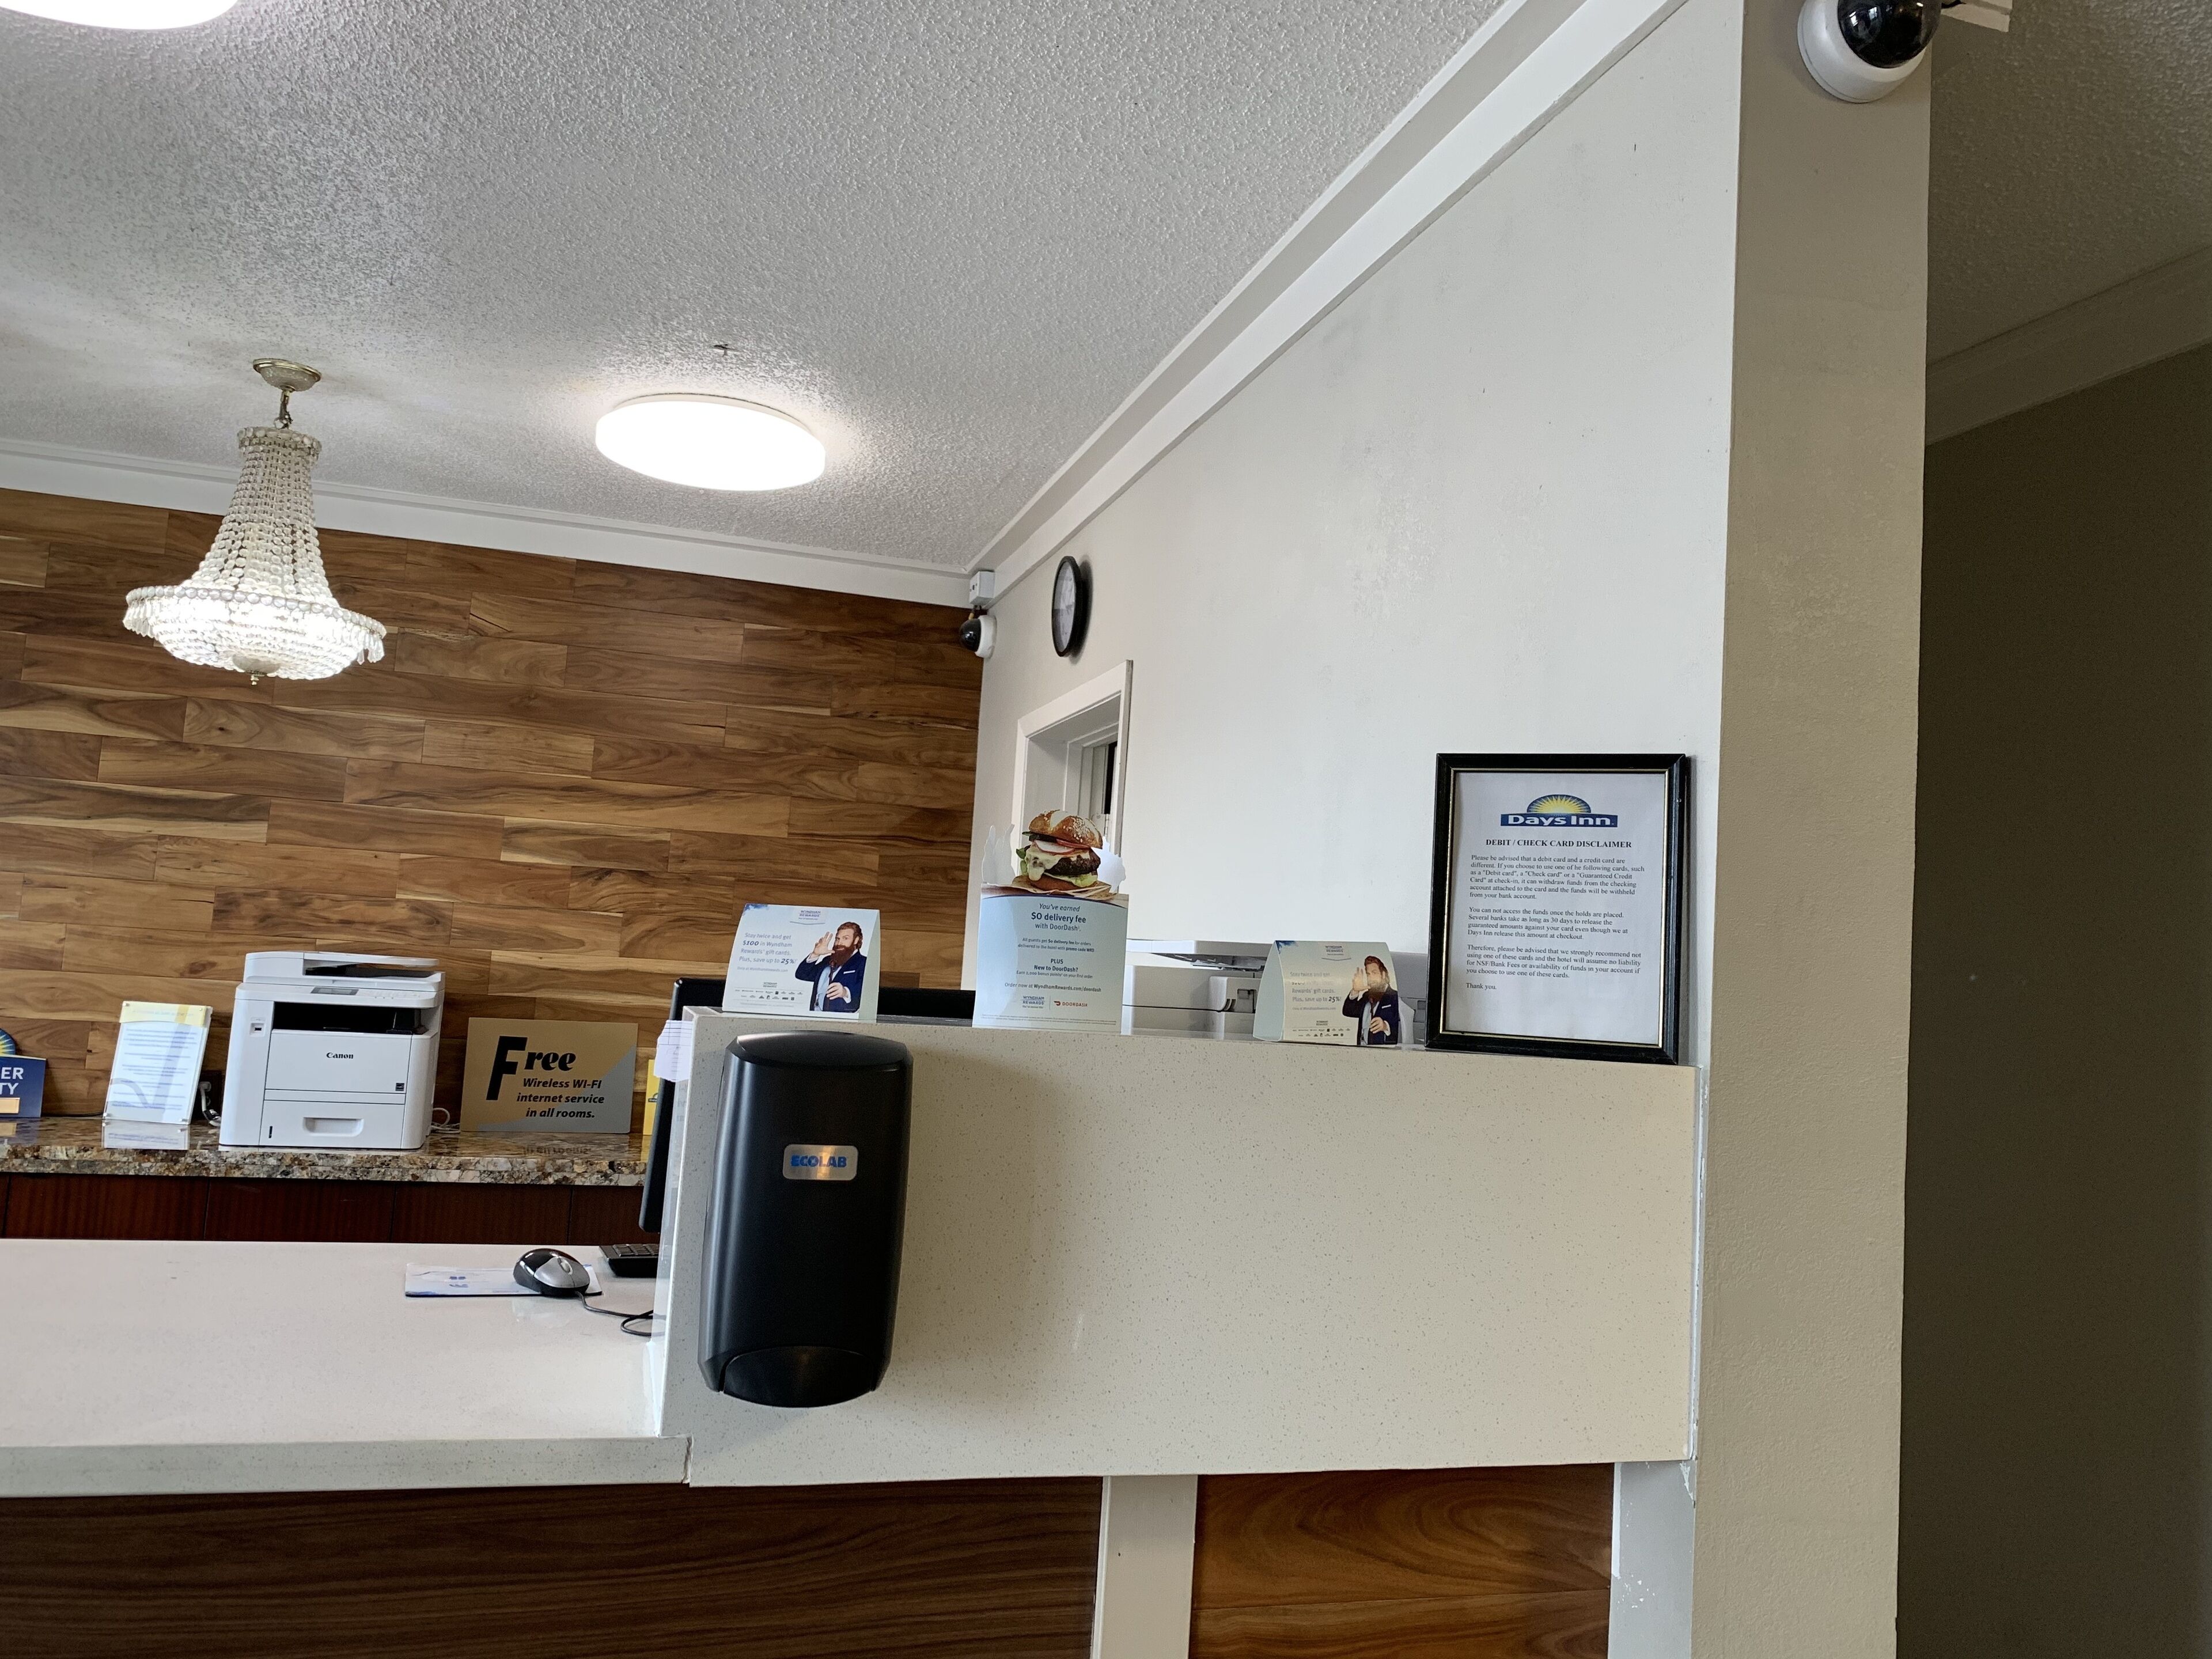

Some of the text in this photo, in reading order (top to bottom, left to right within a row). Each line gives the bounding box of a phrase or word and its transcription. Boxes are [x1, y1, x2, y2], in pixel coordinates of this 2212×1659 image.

[1509, 815, 1566, 825] Days
[1031, 912, 1086, 923] $0 delivery fee
[486, 1036, 576, 1100] Free
[523, 1078, 602, 1089] Wireless WI-FI
[517, 1092, 604, 1104] internet service
[526, 1108, 594, 1118] in all rooms.
[791, 1155, 847, 1167] ECOLAB
